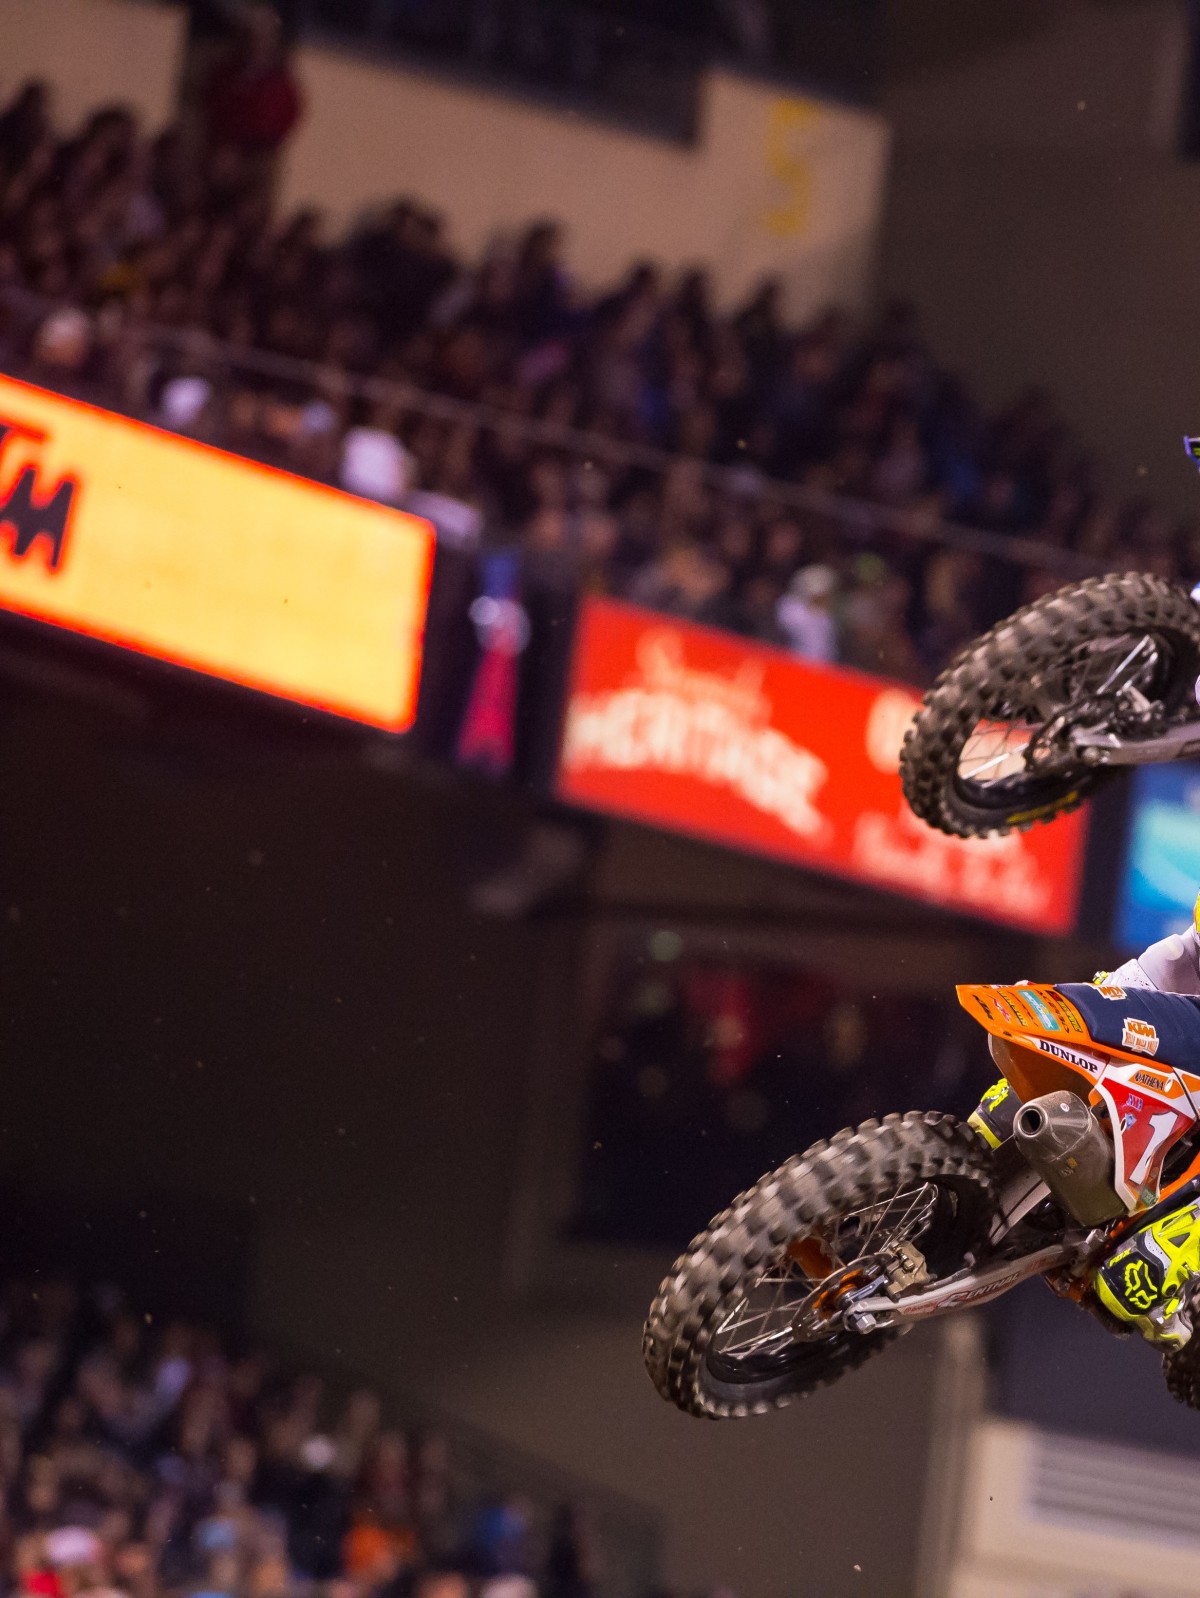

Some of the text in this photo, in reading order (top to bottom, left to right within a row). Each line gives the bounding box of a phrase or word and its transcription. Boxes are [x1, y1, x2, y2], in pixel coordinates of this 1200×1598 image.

[1127, 1020, 1156, 1039] KTM
[1039, 1040, 1098, 1073] DUNLOP
[1129, 1110, 1179, 1185] 1
